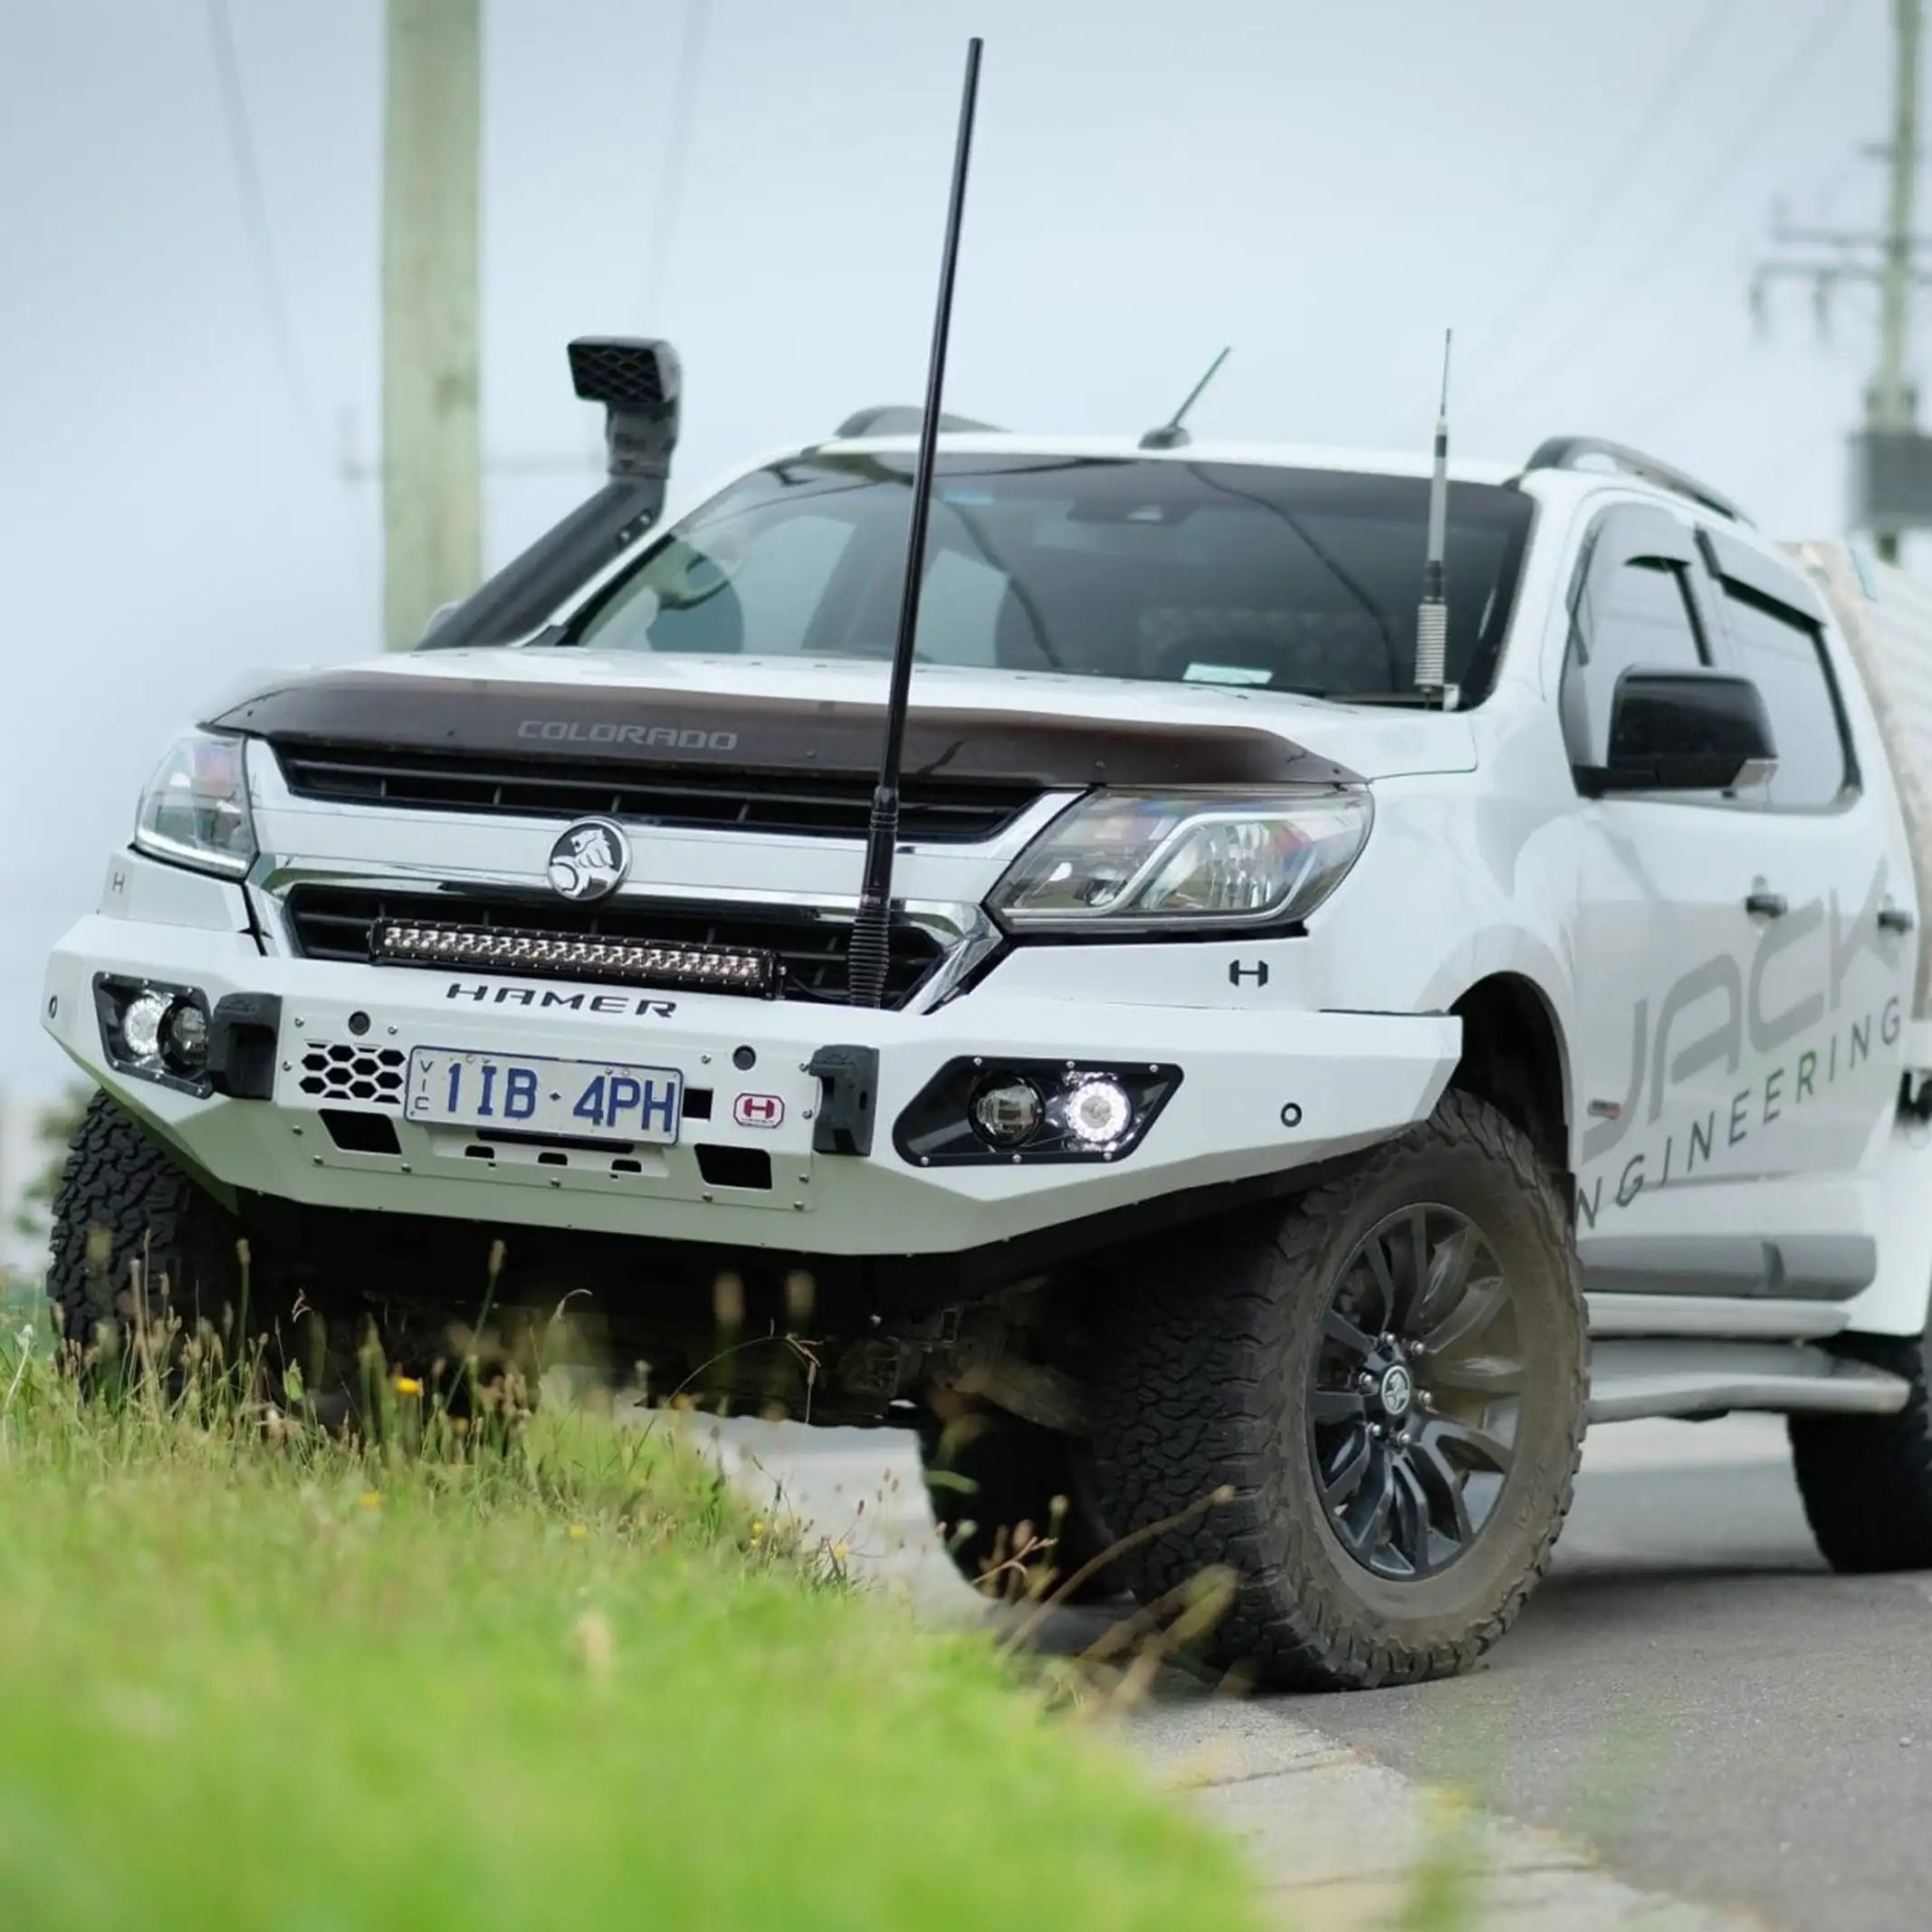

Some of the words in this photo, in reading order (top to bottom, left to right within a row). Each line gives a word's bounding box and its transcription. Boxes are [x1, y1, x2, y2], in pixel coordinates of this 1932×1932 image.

[517, 720, 738, 751] COLORADO
[446, 983, 677, 1019] HAMER
[1582, 855, 1901, 1166] JACK
[415, 1059, 435, 1111] VIC
[572, 1076, 675, 1133] 4PH
[1573, 996, 1900, 1229] NGINEERING
